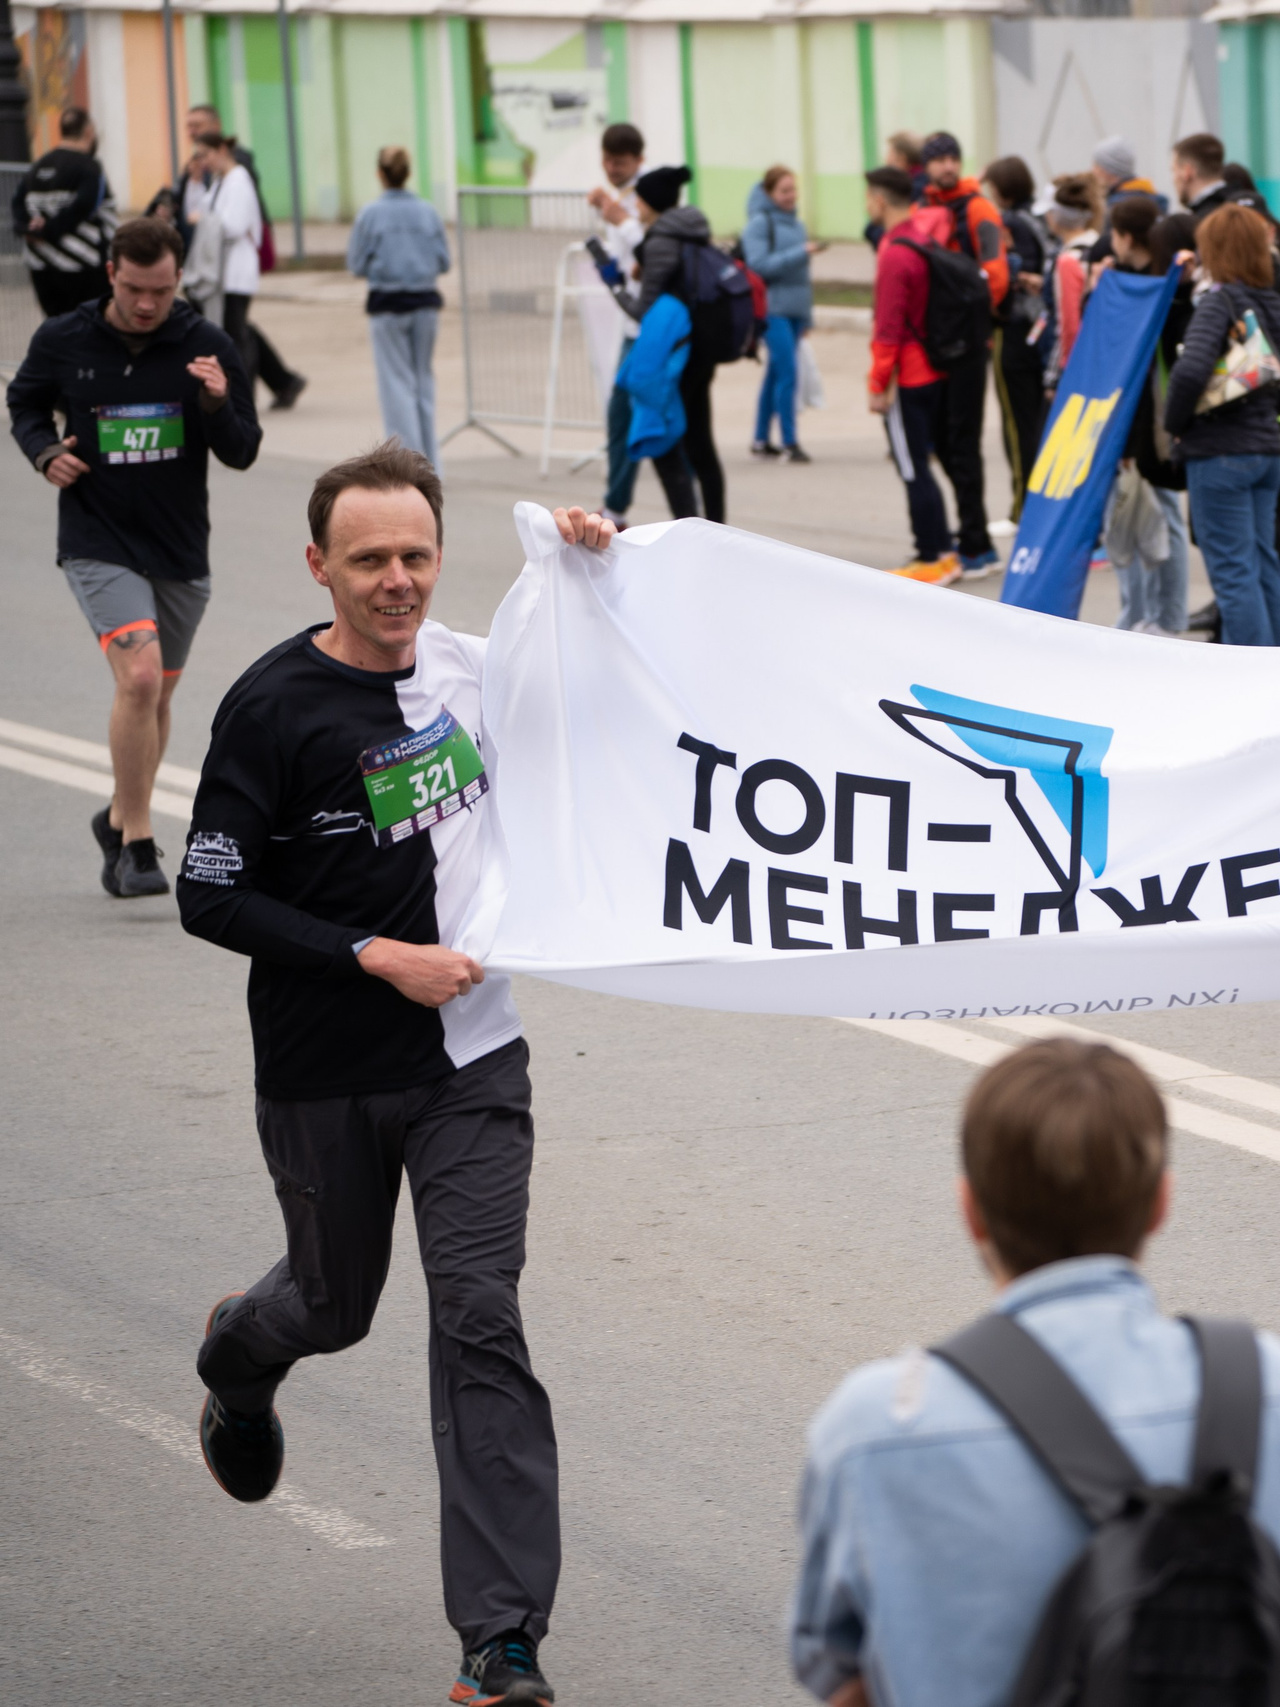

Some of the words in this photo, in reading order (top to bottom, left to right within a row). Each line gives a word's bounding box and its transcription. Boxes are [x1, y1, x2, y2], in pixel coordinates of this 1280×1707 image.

[123, 426, 161, 450] 477
[408, 722, 443, 746] ПРОСТО
[412, 749, 439, 767] ФЕДОР
[408, 755, 458, 809] 321
[677, 731, 991, 873] ТОП-
[187, 853, 242, 868] TURGOYAK
[193, 867, 228, 878] SPORTS
